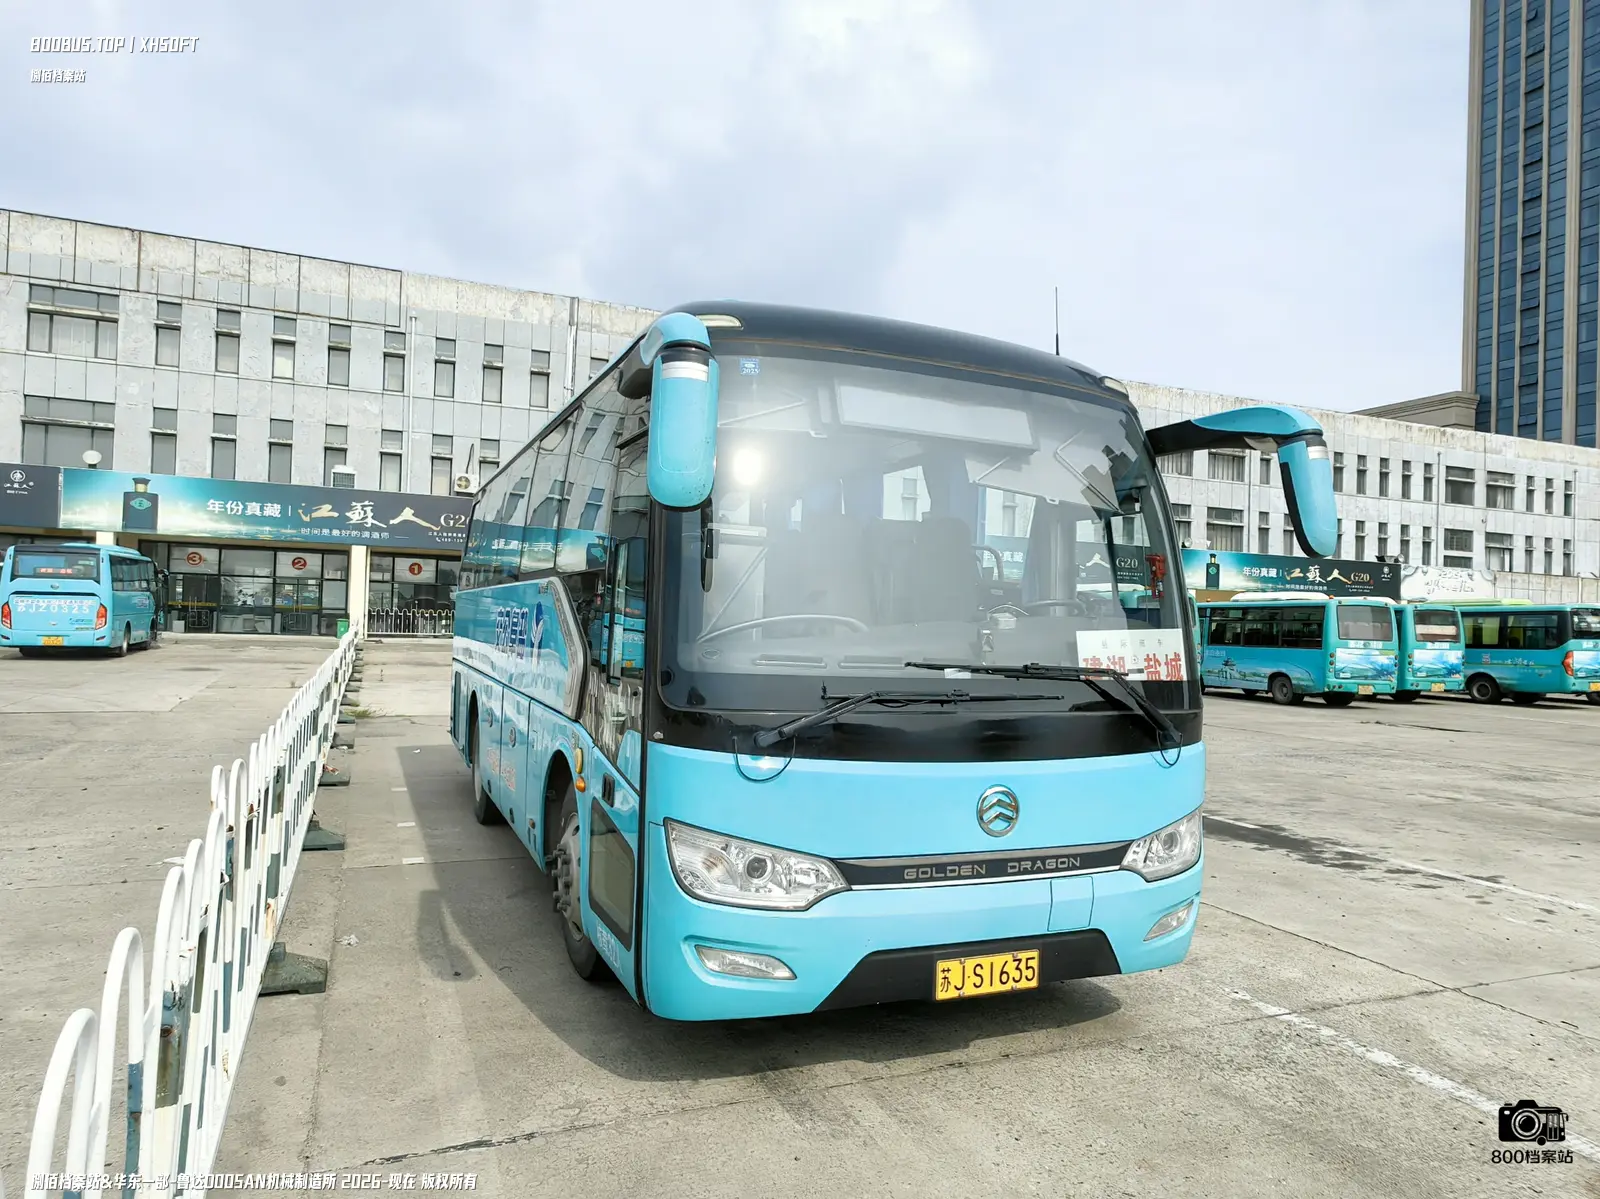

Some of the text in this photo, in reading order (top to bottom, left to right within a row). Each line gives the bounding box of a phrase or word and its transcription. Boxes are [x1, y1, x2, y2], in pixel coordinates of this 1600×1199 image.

[207, 498, 281, 518] 年份真藏
[440, 513, 470, 527] G2
[301, 527, 390, 540] 时间是最好的调酒师
[189, 554, 202, 564] 3
[293, 558, 305, 569] 2
[1116, 557, 1138, 568] G20
[1242, 567, 1277, 577] 年份真藏
[1351, 572, 1370, 582] G20
[904, 857, 1081, 879] GOLDEN DRAGON
